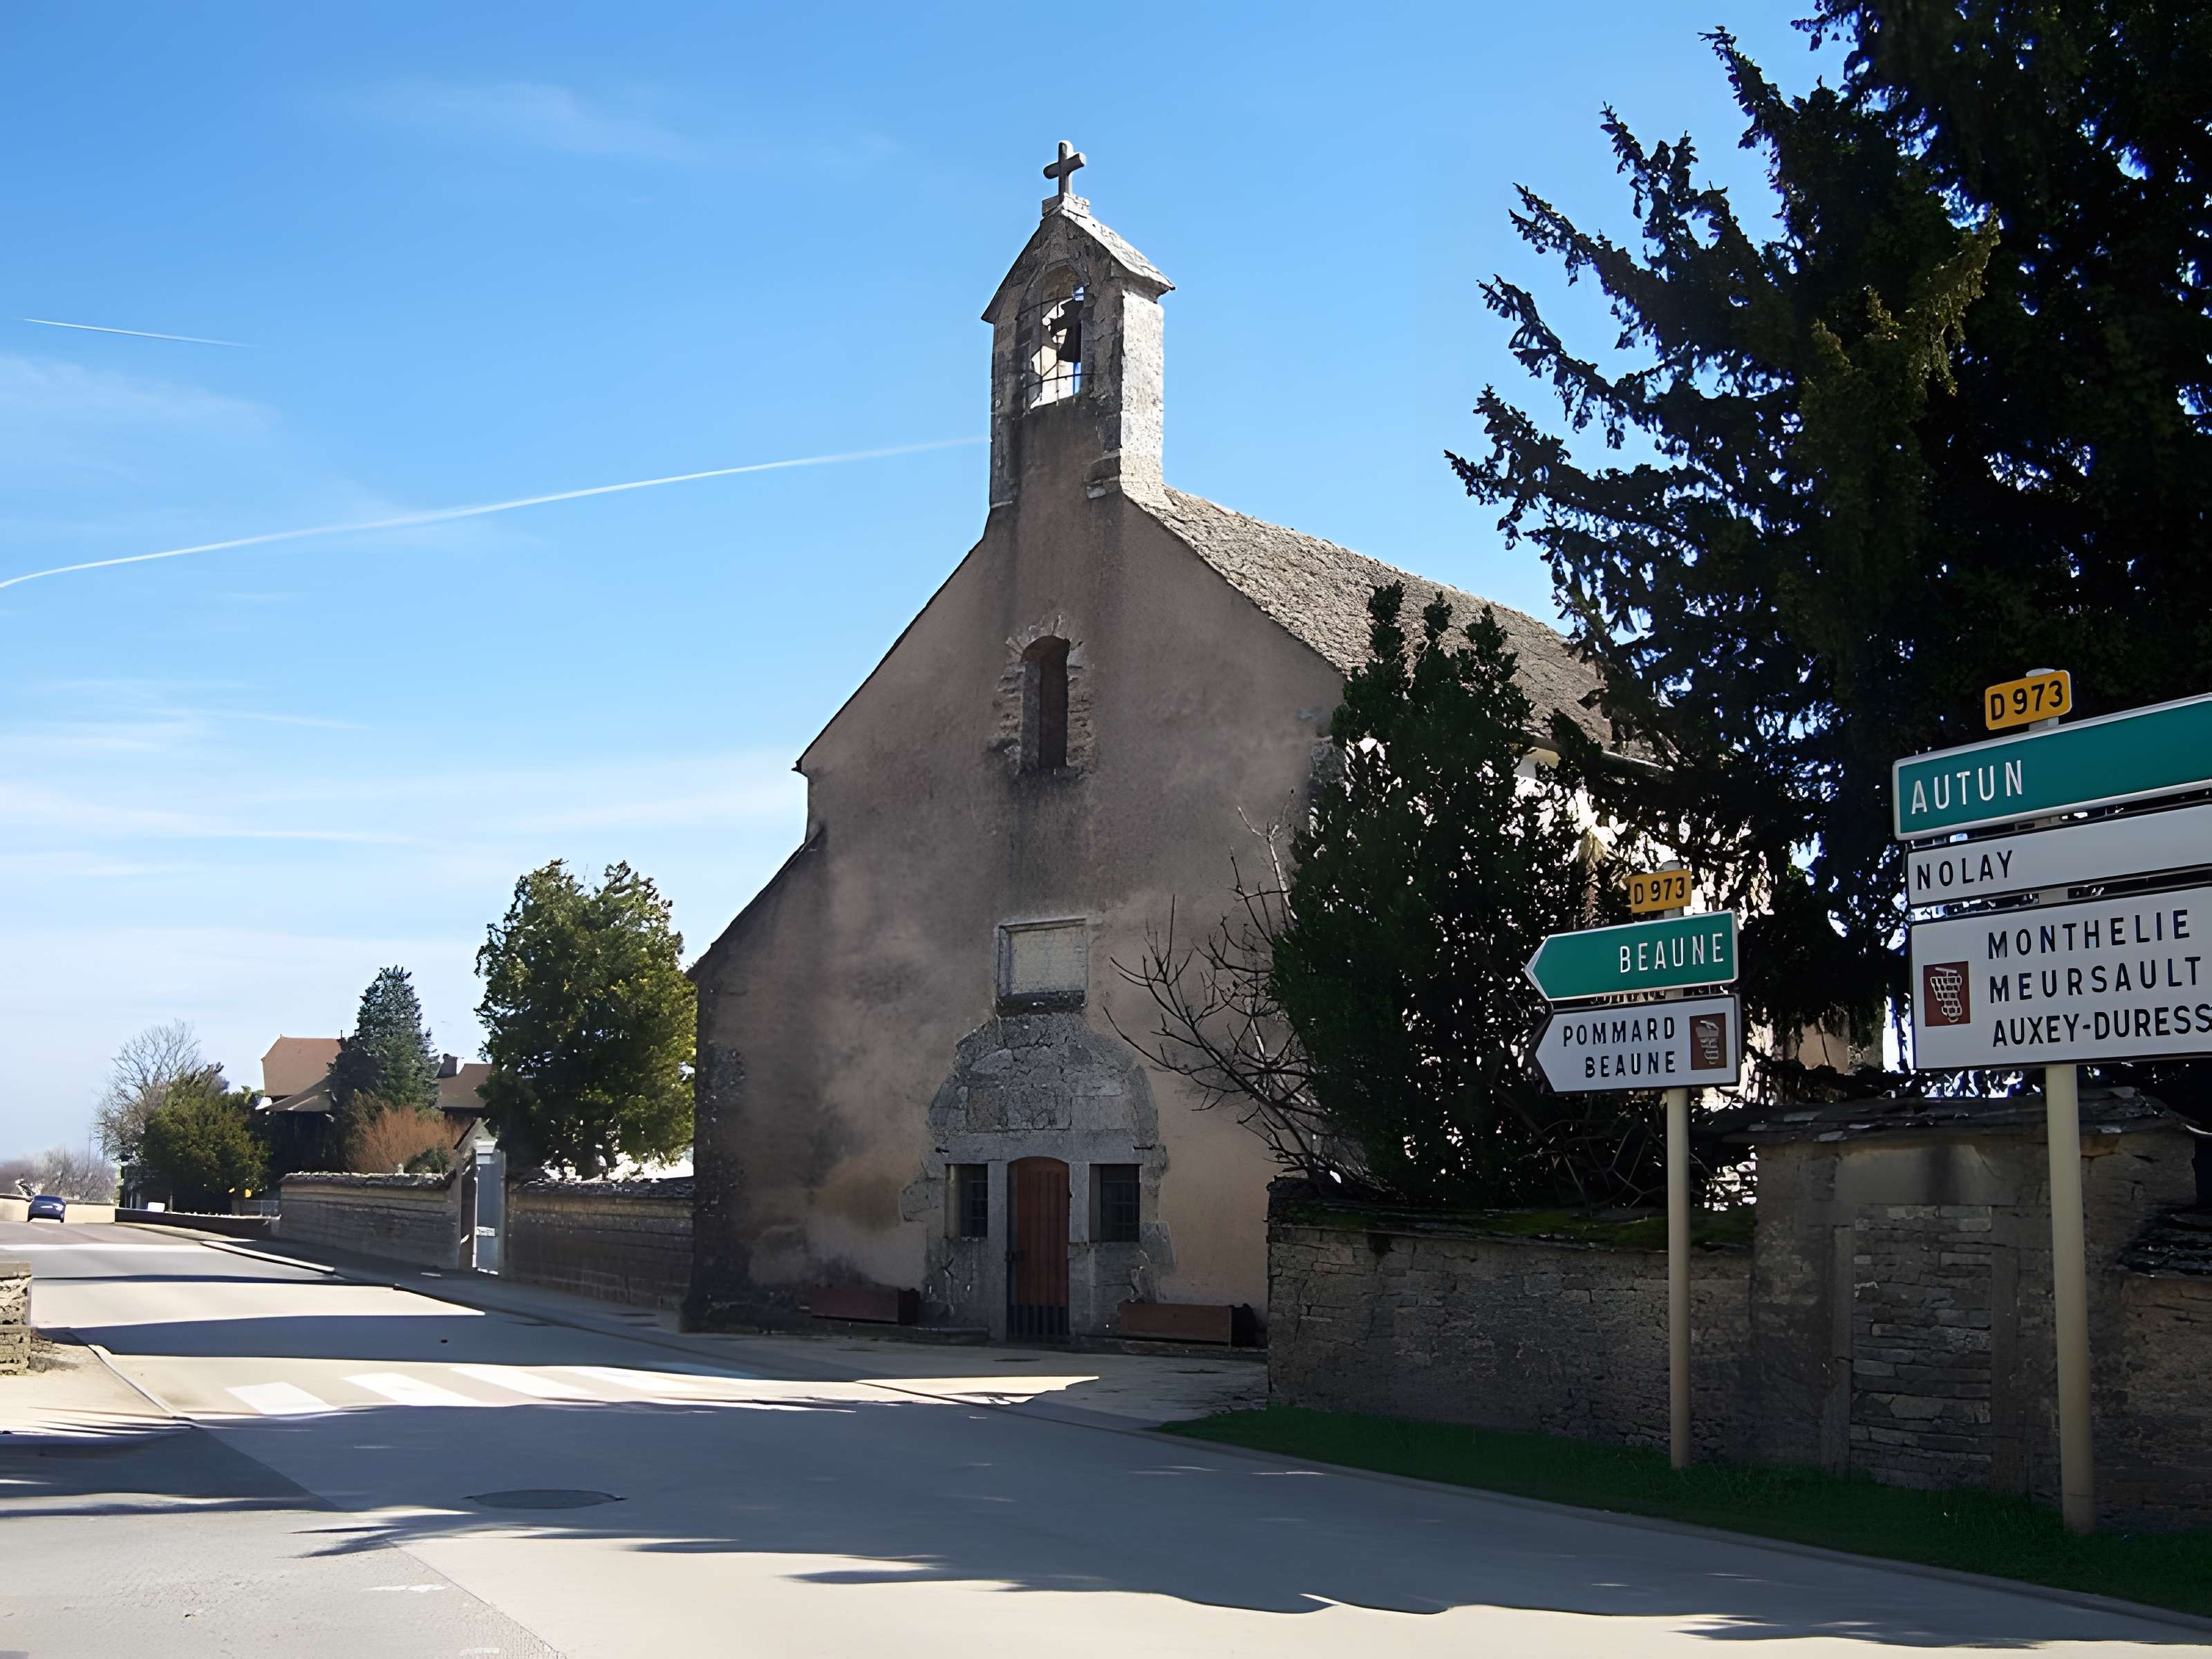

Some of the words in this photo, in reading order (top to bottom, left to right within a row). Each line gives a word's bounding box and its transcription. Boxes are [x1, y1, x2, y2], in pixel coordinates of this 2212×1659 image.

[1990, 693, 2005, 720] D
[2013, 680, 2063, 714] 973
[1911, 760, 2023, 814] AUTUN
[1917, 850, 2013, 890] NOLAY
[1634, 883, 1644, 905] D
[1651, 877, 1685, 901] 973
[1620, 932, 1723, 973] BEAUNE
[1988, 909, 2190, 959] MONTHELIE
[1989, 956, 2201, 1004] MEURSAULT
[1563, 1017, 1675, 1047] POMMARD
[1585, 1051, 1676, 1078] BEAUNE
